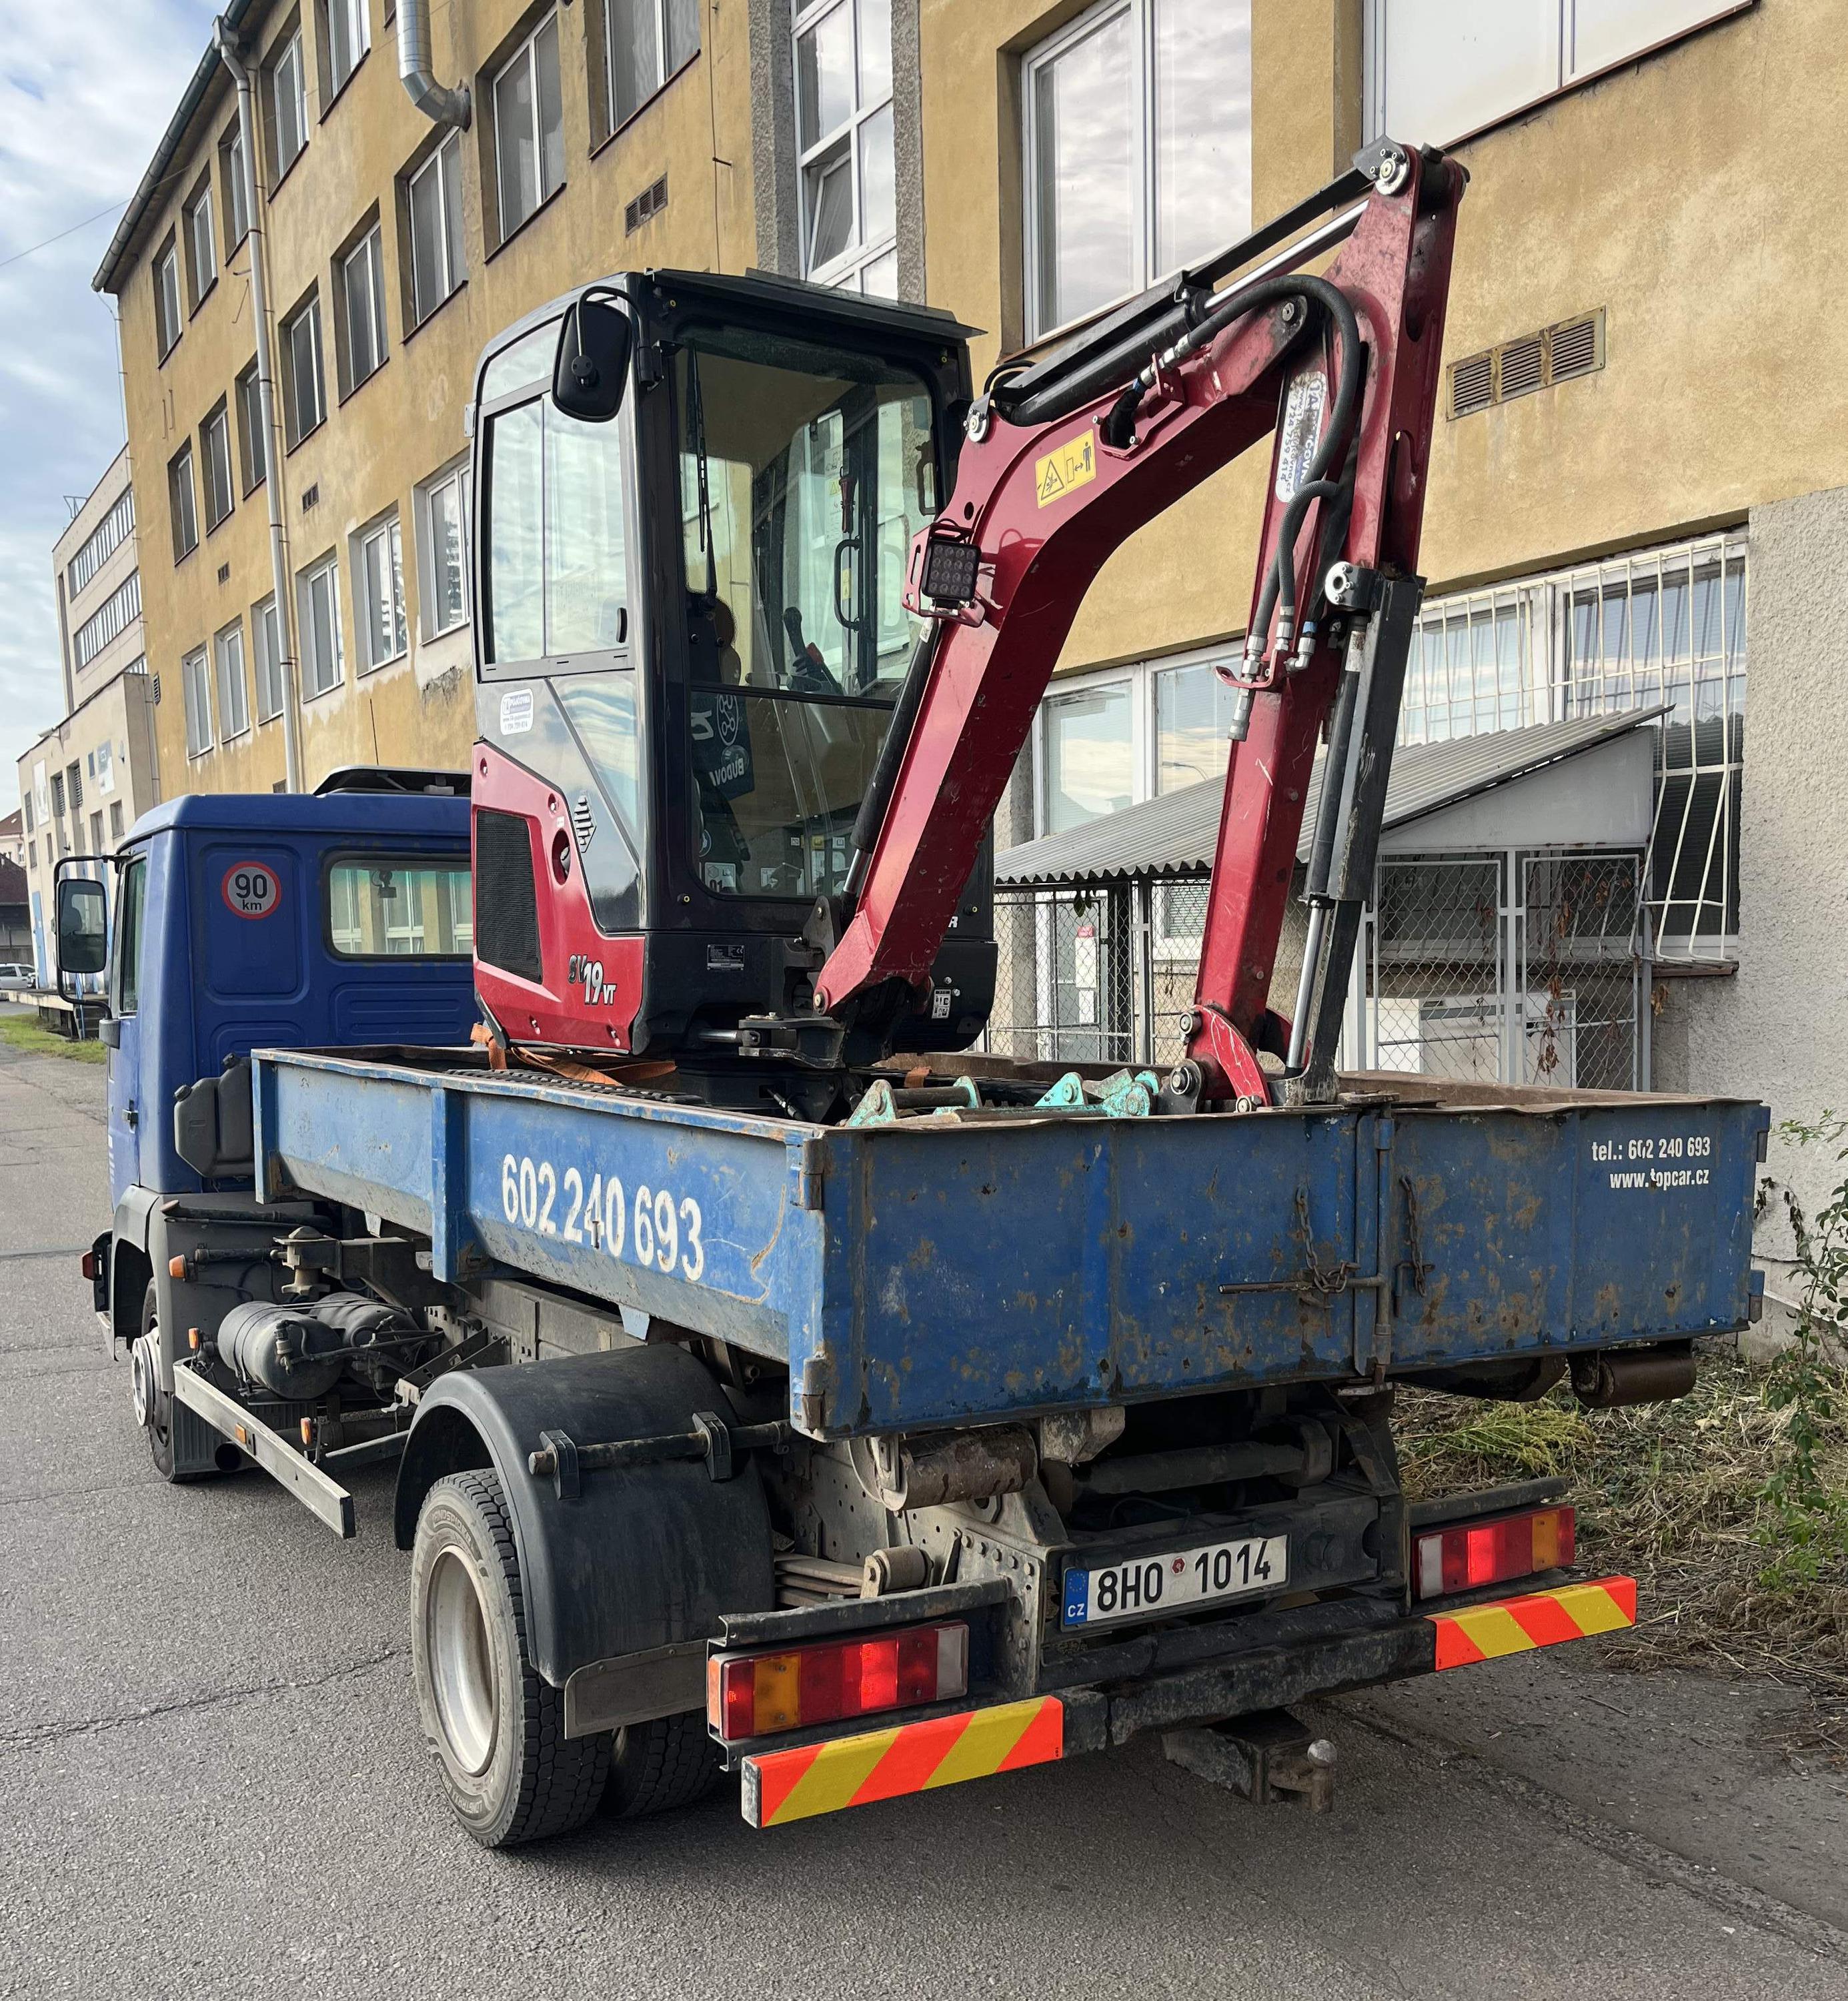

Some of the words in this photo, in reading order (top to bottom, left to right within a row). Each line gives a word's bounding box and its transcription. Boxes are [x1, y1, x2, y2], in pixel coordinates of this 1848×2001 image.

[1288, 405, 1297, 428] 724
[1284, 431, 1292, 454] 759
[1280, 458, 1288, 482] 414
[235, 874, 268, 899] 90
[242, 899, 262, 910] km
[1591, 1140, 1623, 1161] tel.:
[1628, 1139, 1654, 1160] 602
[1659, 1138, 1683, 1158] 240
[1687, 1137, 1711, 1157] 693
[1609, 1168, 1709, 1191] www.topcar.cz
[502, 1153, 557, 1235] 602
[564, 1167, 626, 1257] 240
[634, 1185, 704, 1281] 693
[1194, 1540, 1271, 1593] 1014
[1067, 1603, 1085, 1618] CZ
